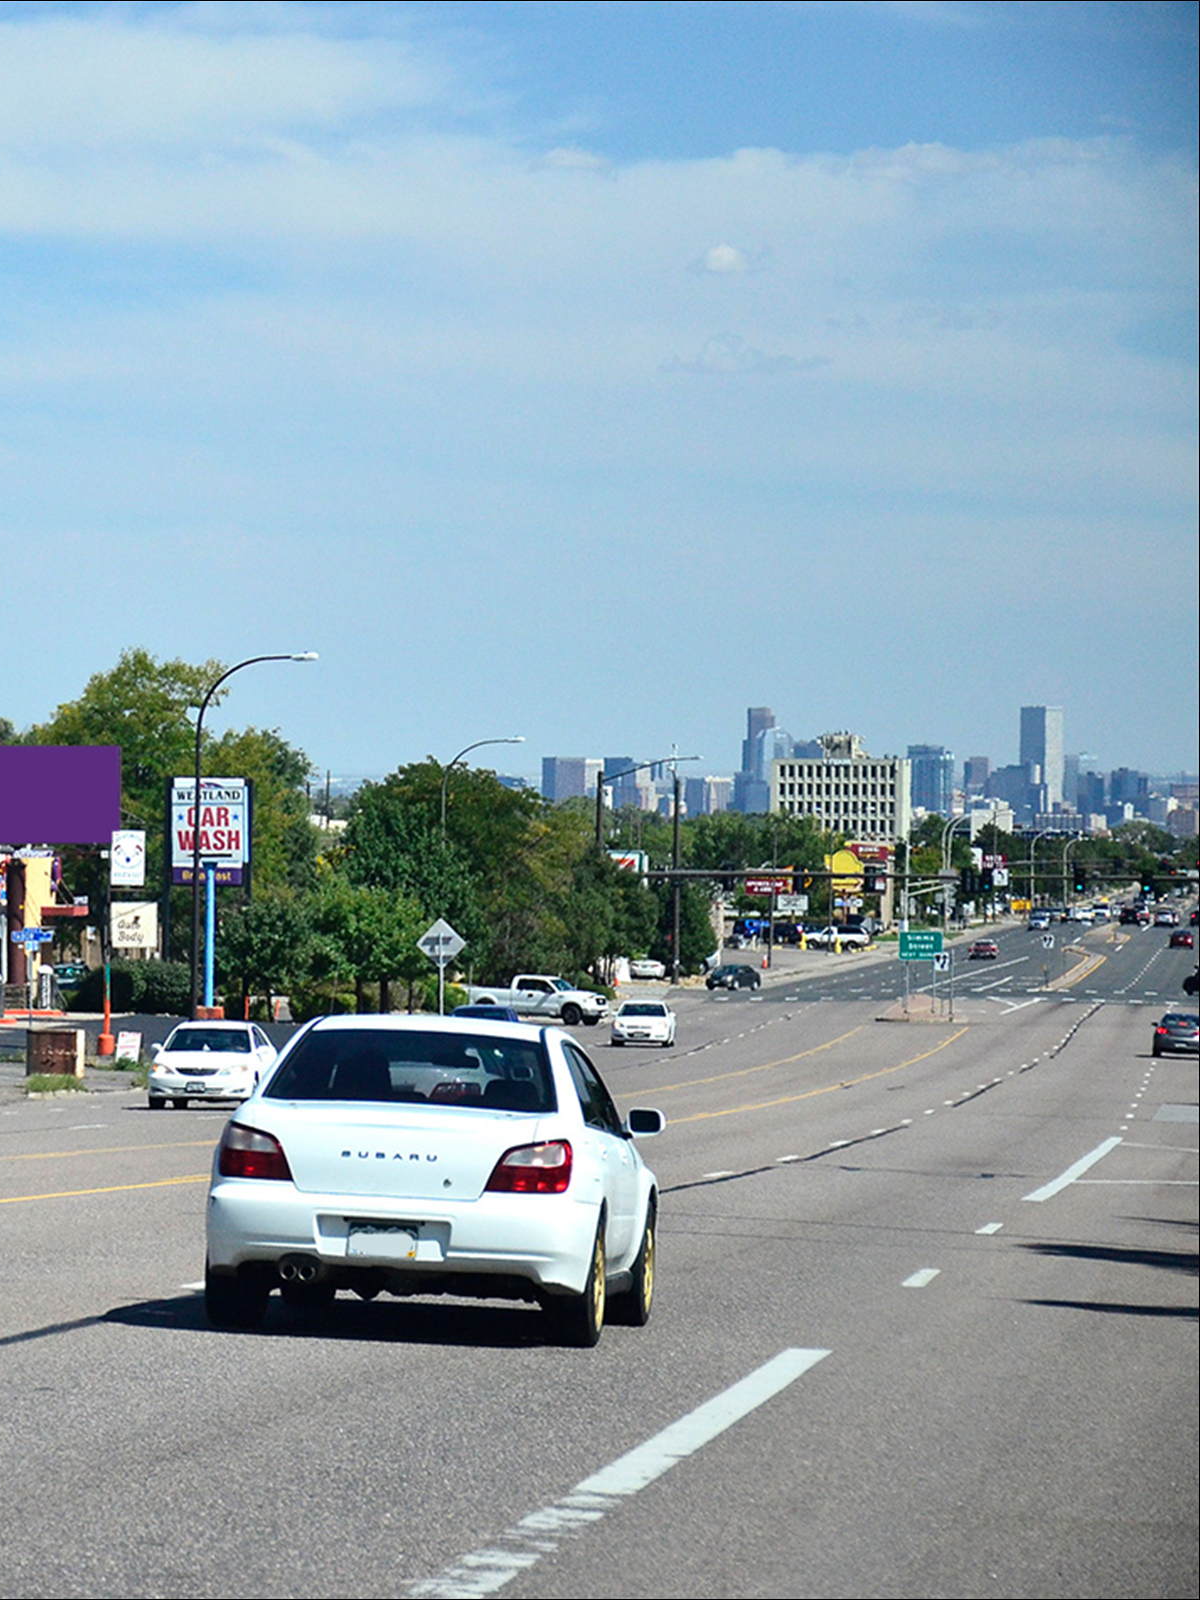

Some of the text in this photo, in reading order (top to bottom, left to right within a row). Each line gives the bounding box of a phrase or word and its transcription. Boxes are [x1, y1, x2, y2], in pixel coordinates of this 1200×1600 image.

[187, 806, 230, 827] CAR
[177, 829, 241, 851] WASH
[908, 942, 934, 950] Street
[340, 1150, 438, 1162] SUBARU
